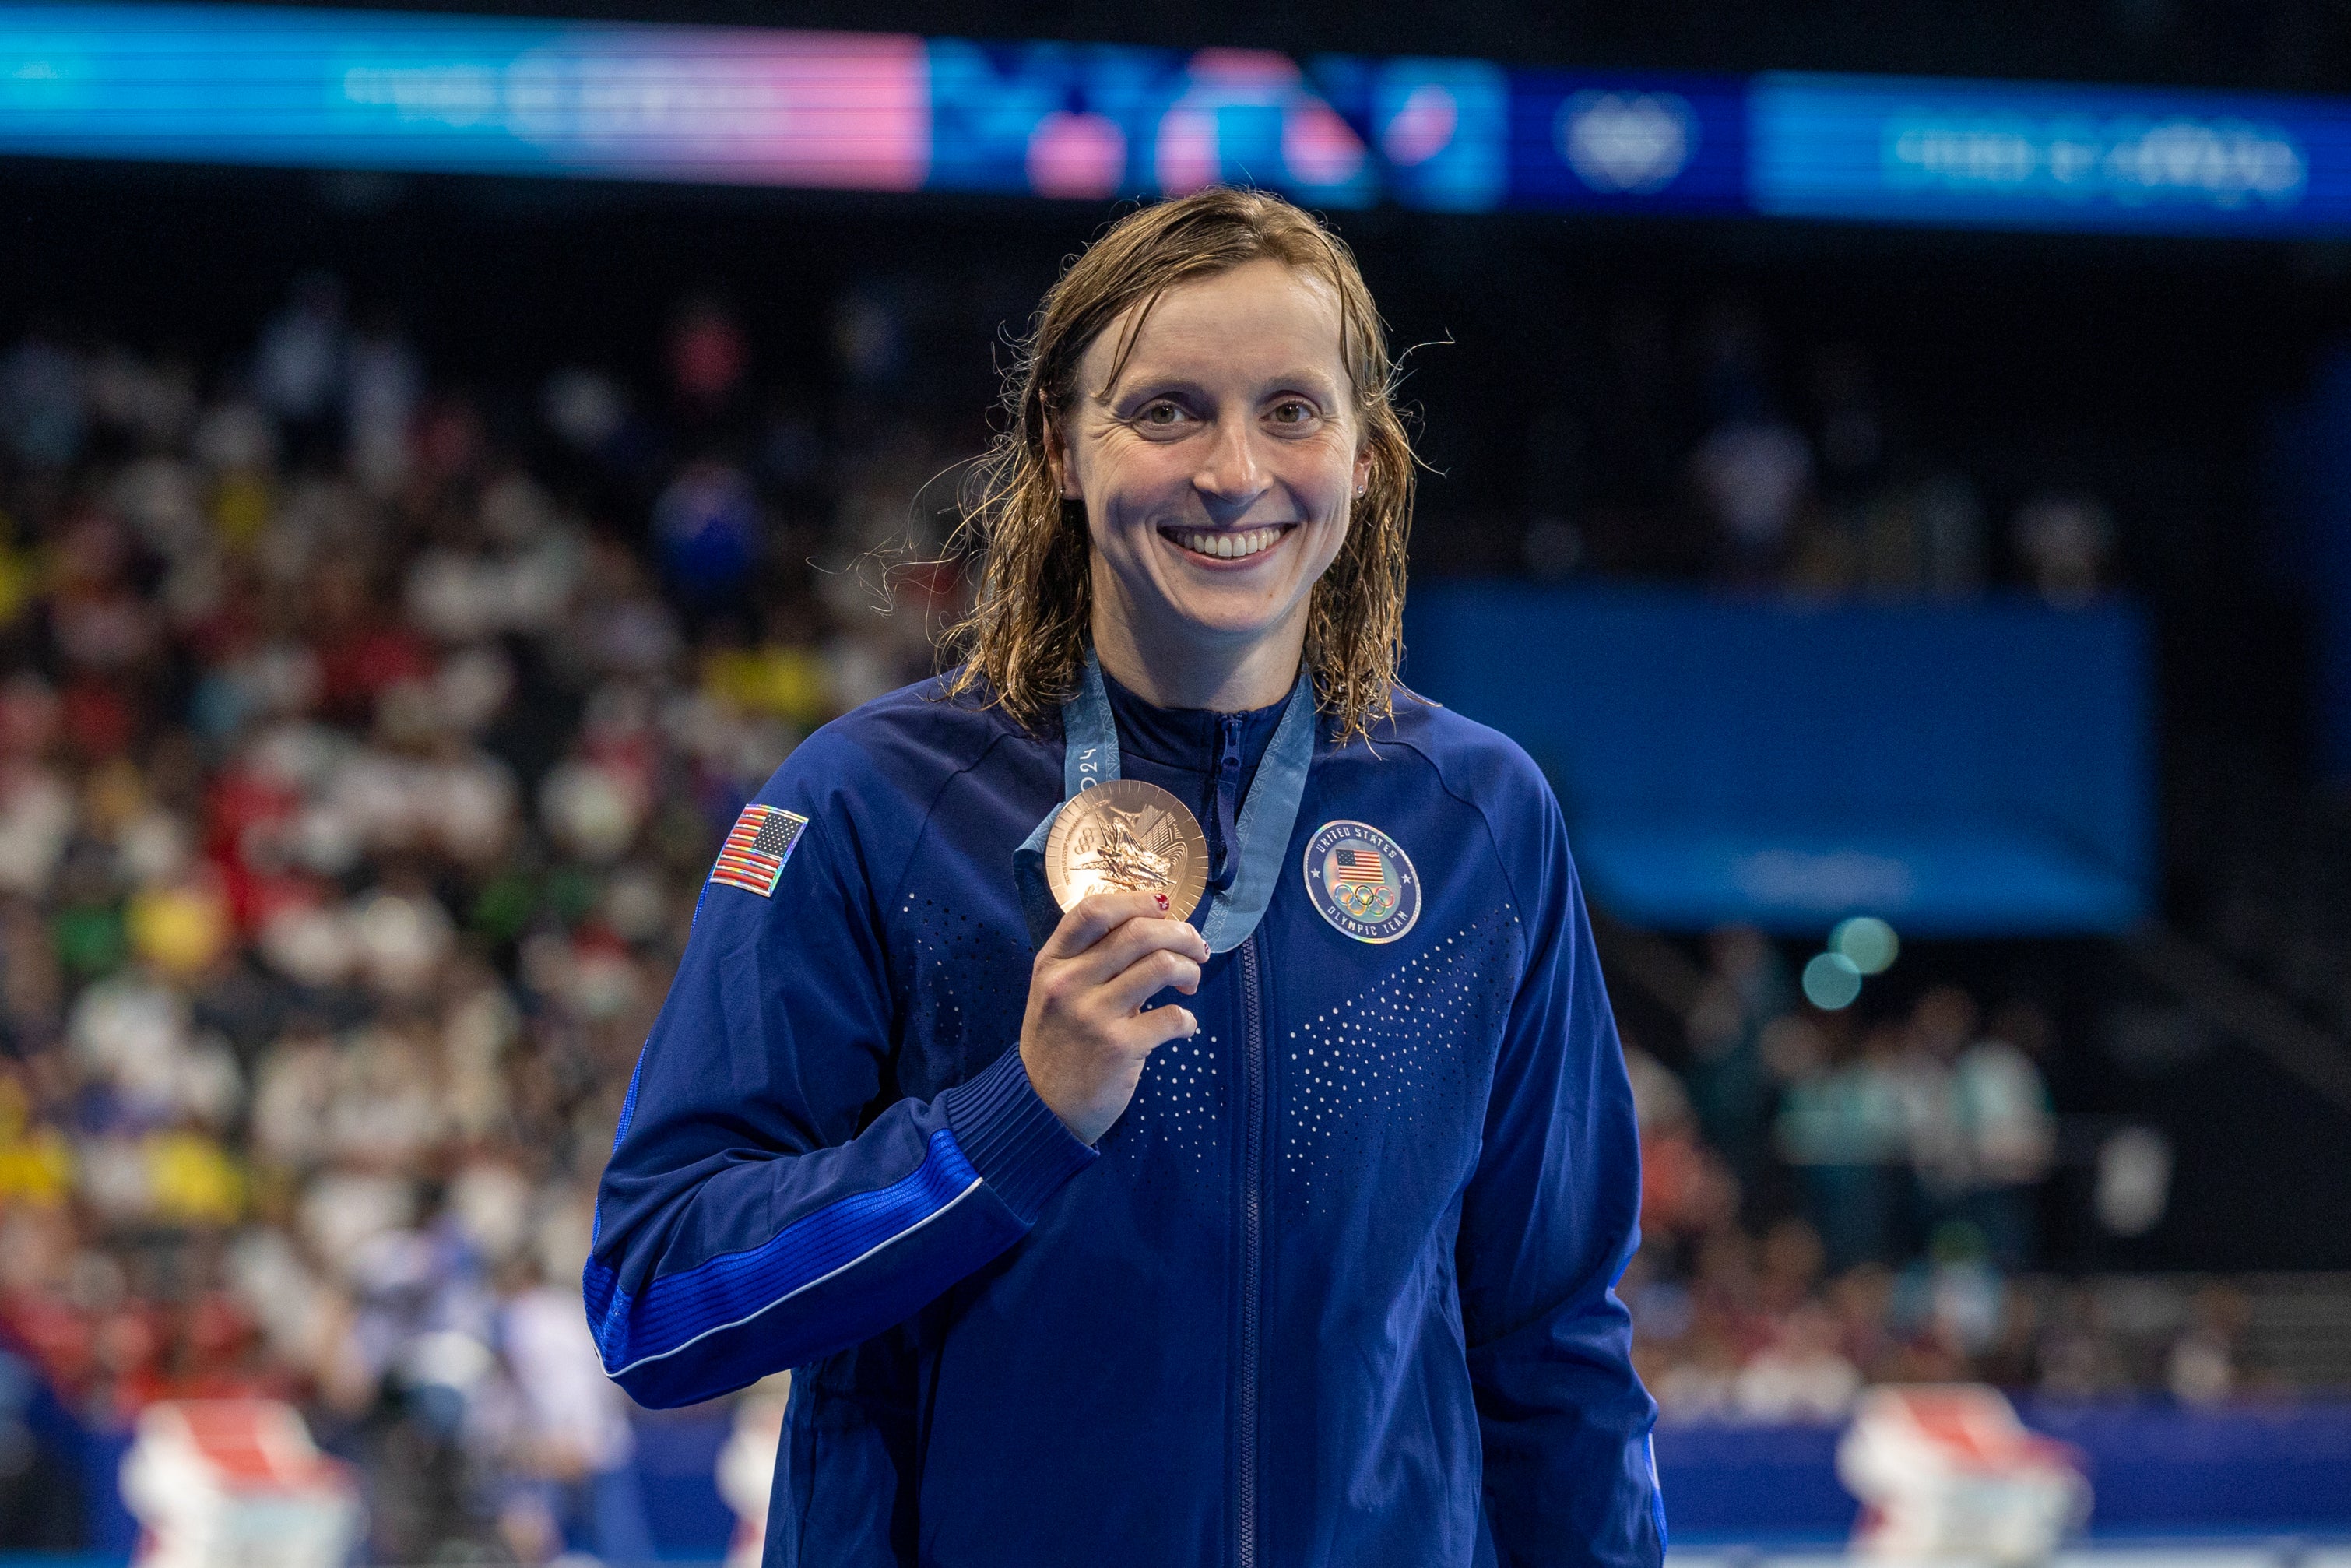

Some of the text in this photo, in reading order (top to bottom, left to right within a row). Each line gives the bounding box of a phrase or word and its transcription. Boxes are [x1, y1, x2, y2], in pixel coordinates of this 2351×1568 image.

[1316, 827, 1397, 859] UNITED STATES
[1327, 905, 1408, 936] OLYMPIC TEAM
